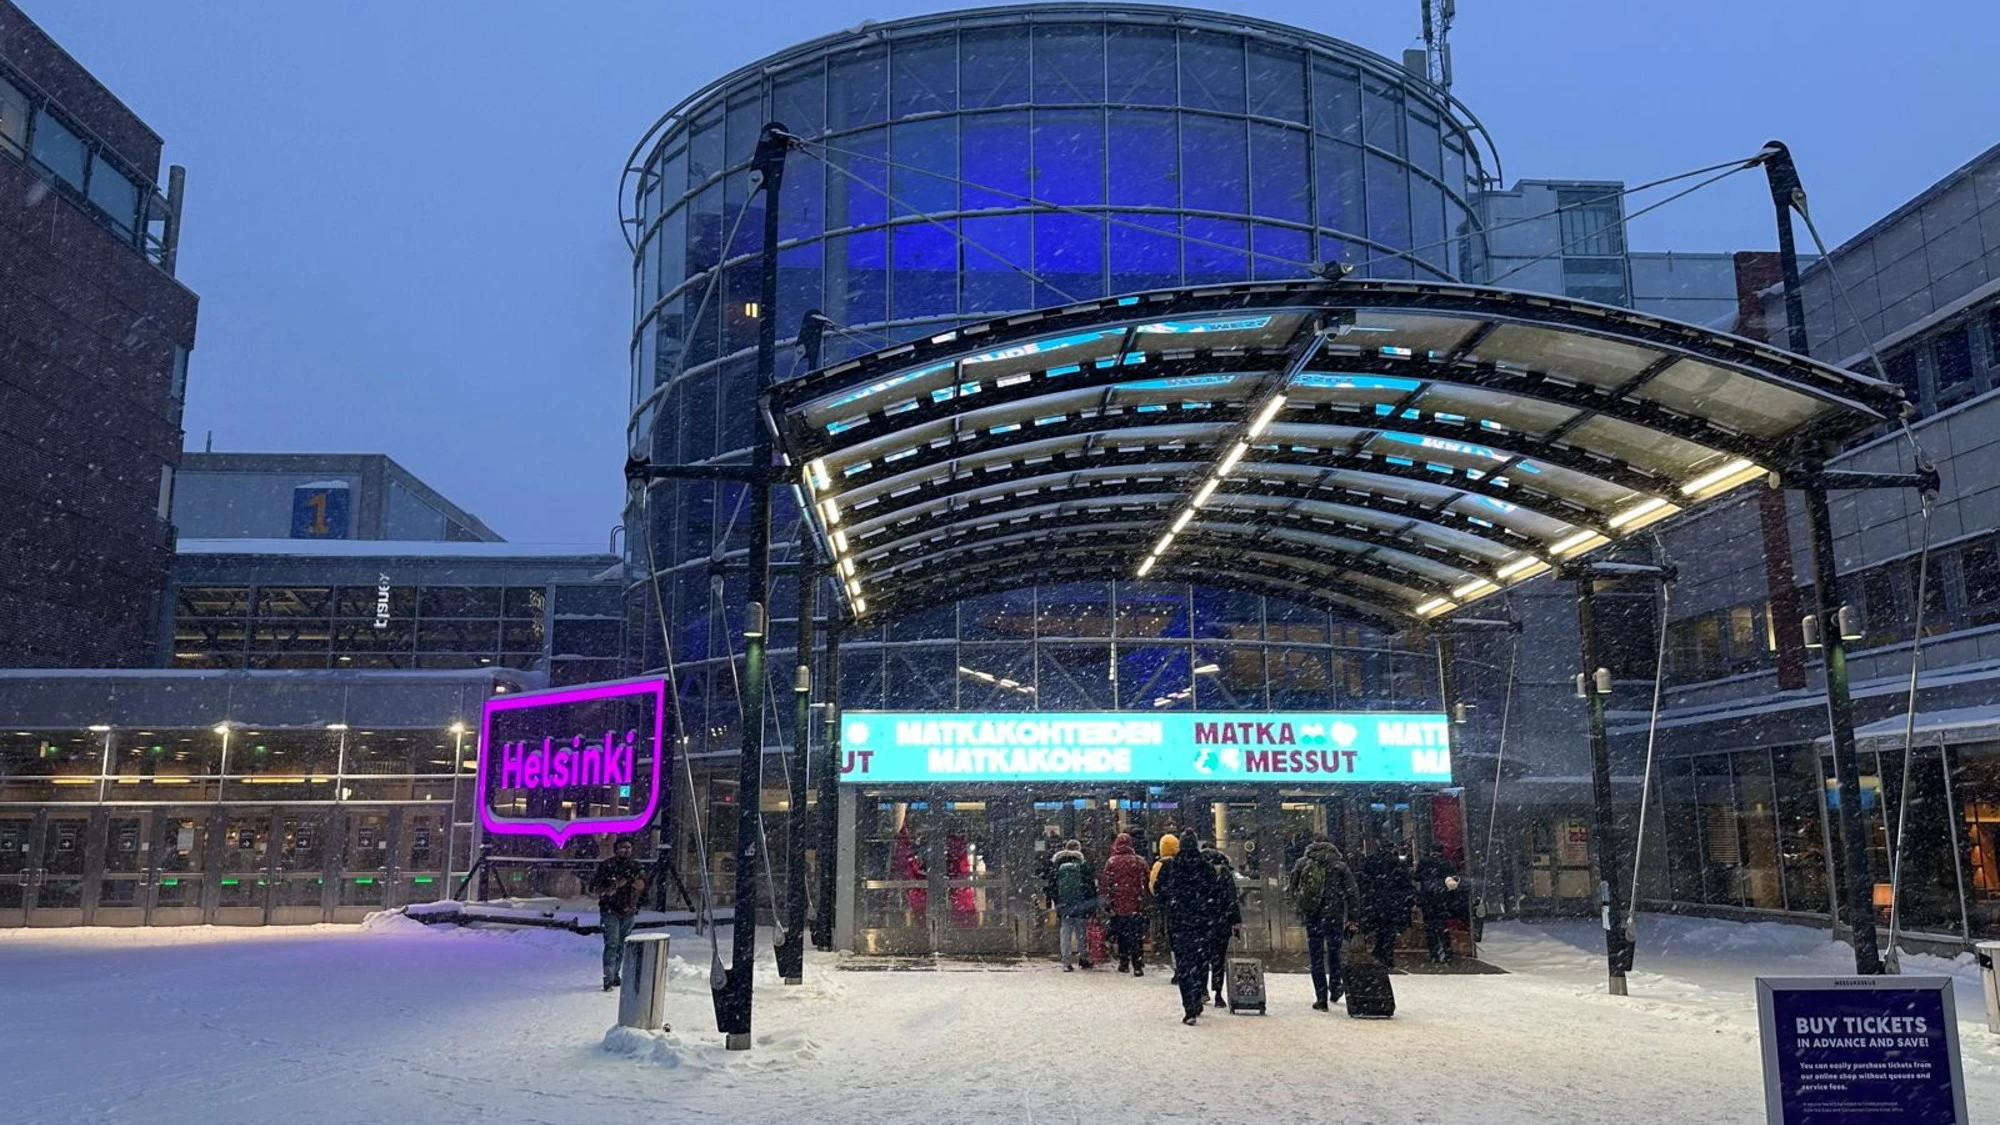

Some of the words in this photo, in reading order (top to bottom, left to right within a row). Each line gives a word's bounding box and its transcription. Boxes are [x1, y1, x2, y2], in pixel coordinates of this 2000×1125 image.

[304, 493, 329, 535] 1
[895, 720, 1163, 746] MATKAKOHTEIDEN
[1194, 721, 1297, 745] MATKA
[501, 730, 635, 790] Helsinki
[927, 748, 1132, 774] MATKAKOHDE
[1245, 749, 1358, 774] MESSUT
[1796, 1017, 1837, 1033] BUY
[1843, 1017, 1927, 1033] TICKETS
[1797, 1038, 1810, 1048] IN
[1812, 1037, 1867, 1048] ADVANCE
[1869, 1037, 1895, 1047] AND
[1897, 1037, 1929, 1047] SAVE!
[1829, 1062, 1851, 1071] easily
[1852, 1061, 1887, 1071] purchase
[1888, 1061, 1912, 1069] tickets
[1913, 1061, 1932, 1069] from
[1839, 1072, 1857, 1081] shop
[1858, 1071, 1887, 1079] without
[1888, 1072, 1915, 1080] queues
[1916, 1071, 1931, 1079] and
